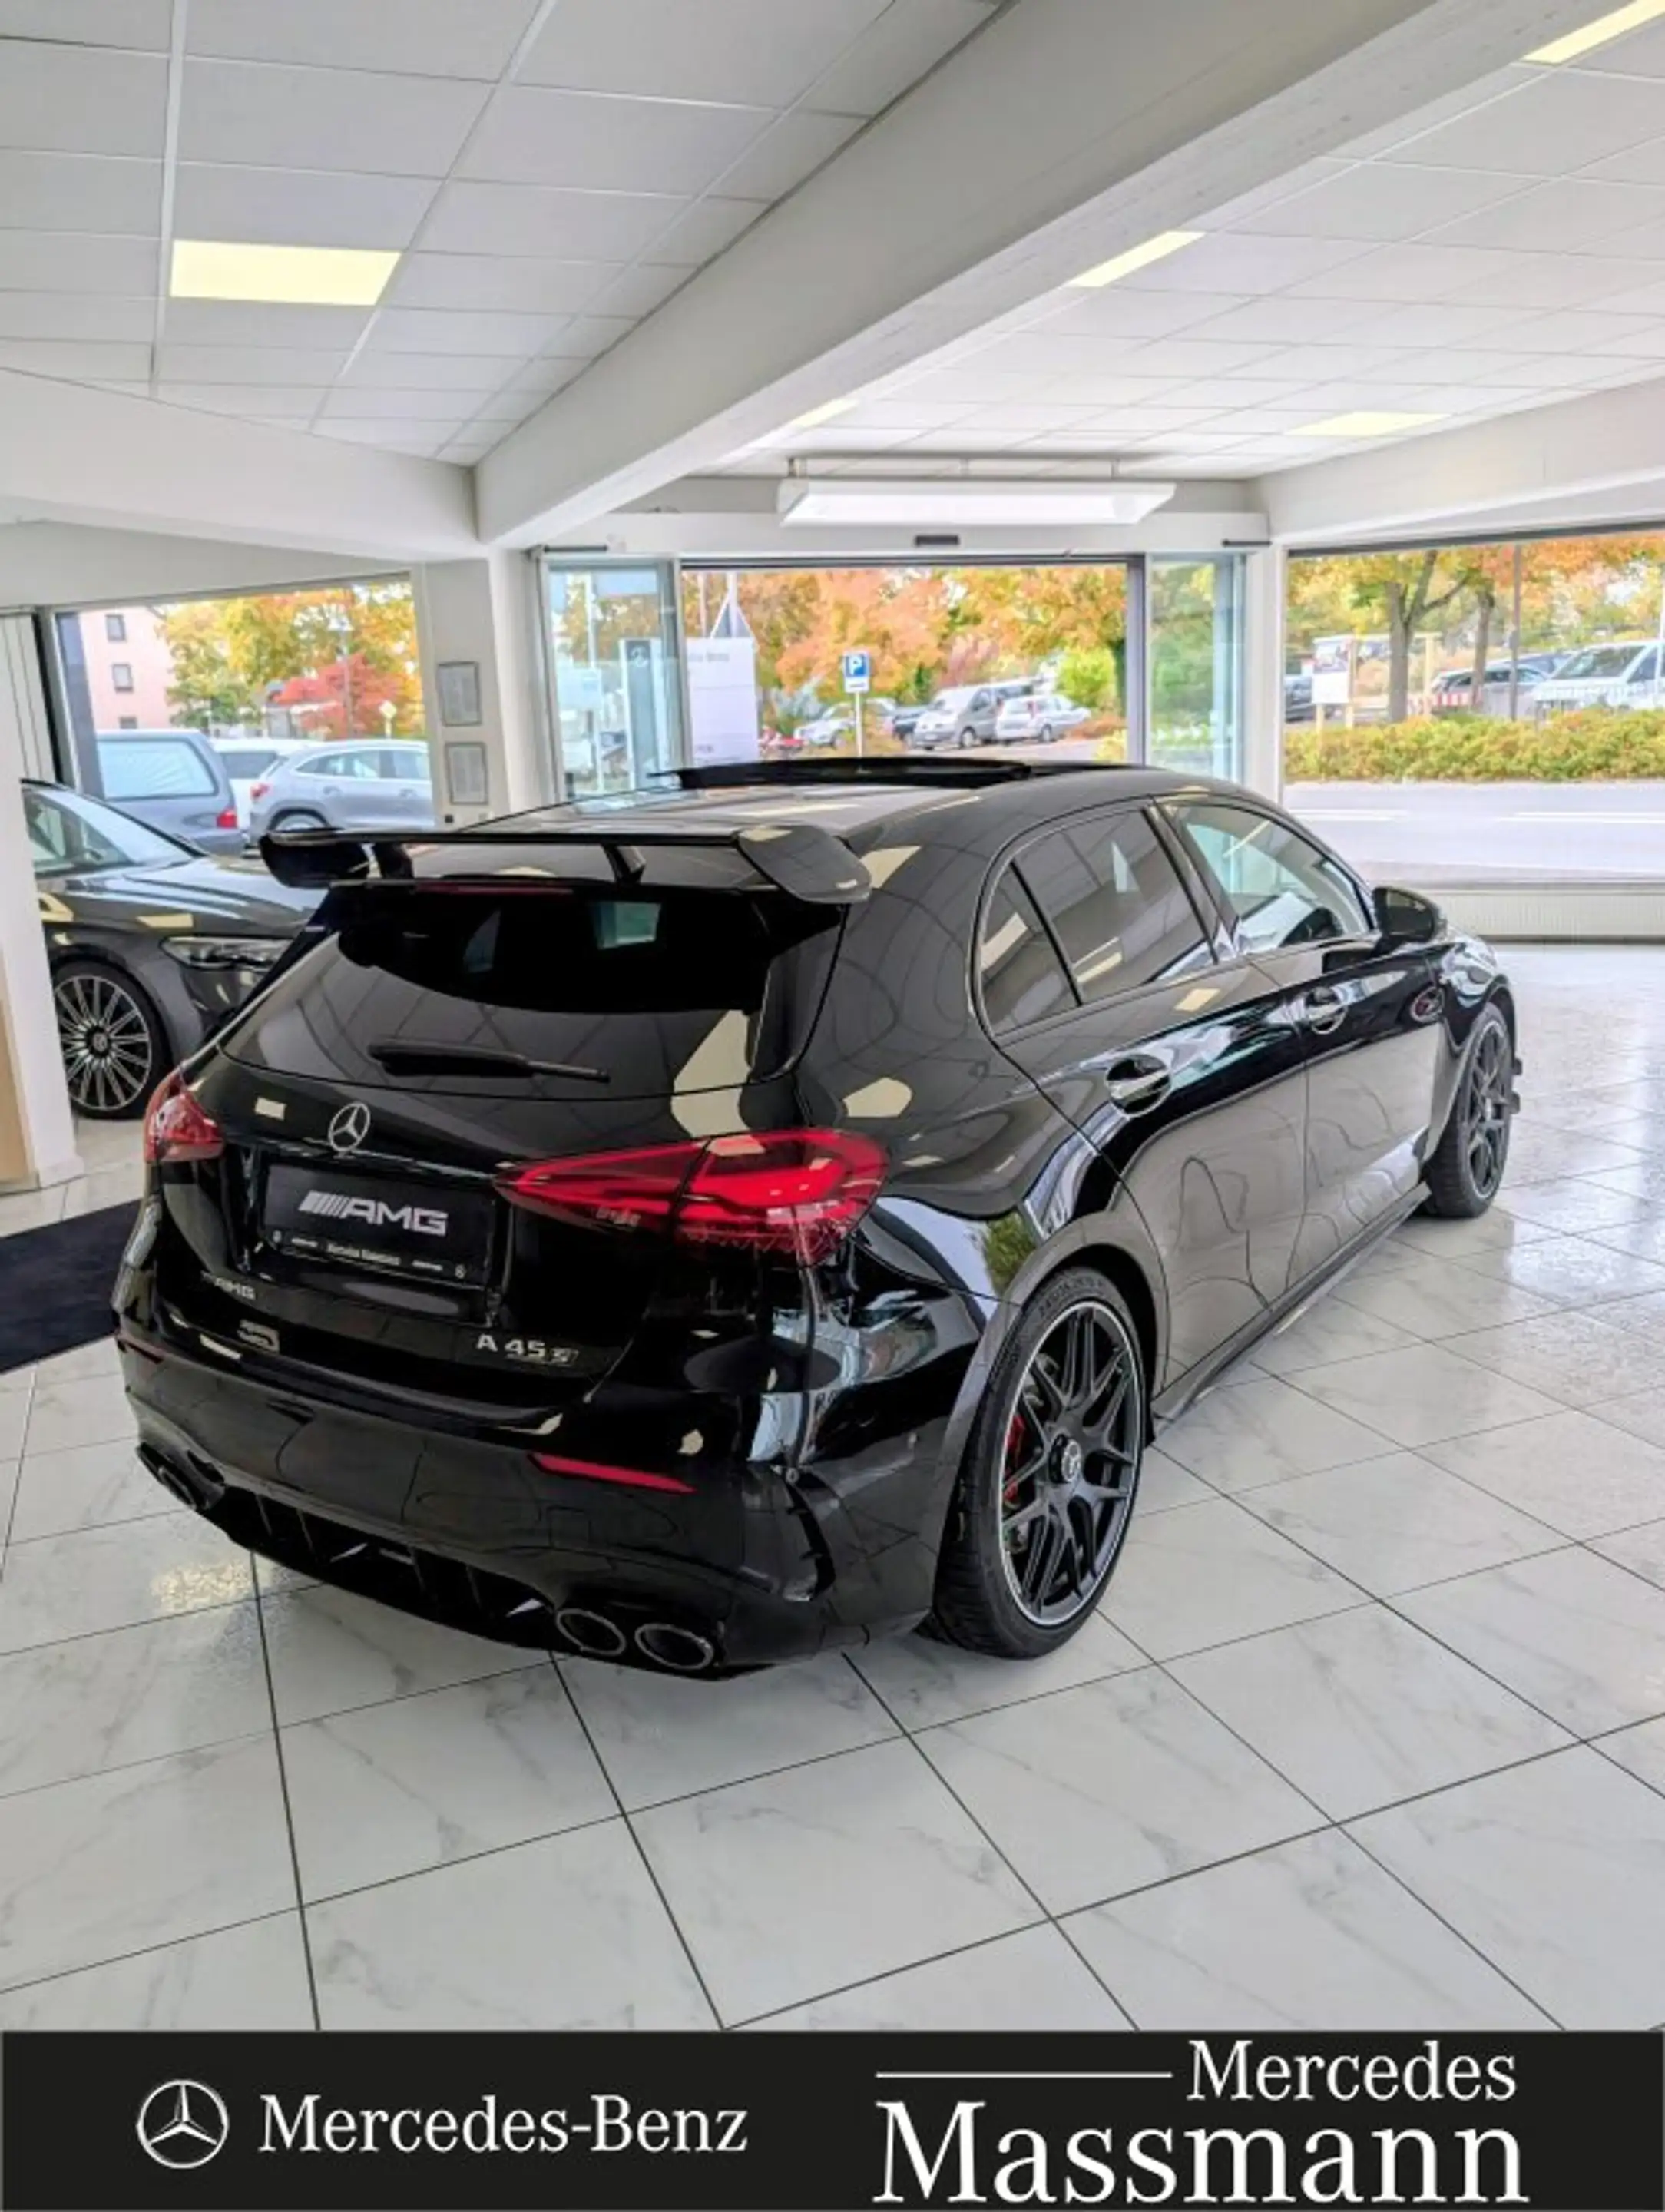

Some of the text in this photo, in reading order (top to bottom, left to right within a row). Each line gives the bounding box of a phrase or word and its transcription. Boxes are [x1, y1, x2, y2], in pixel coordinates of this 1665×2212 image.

[849, 656, 862, 675] P
[339, 1197, 449, 1237] AMG
[476, 1333, 498, 1353] A
[504, 1339, 546, 1357] 45
